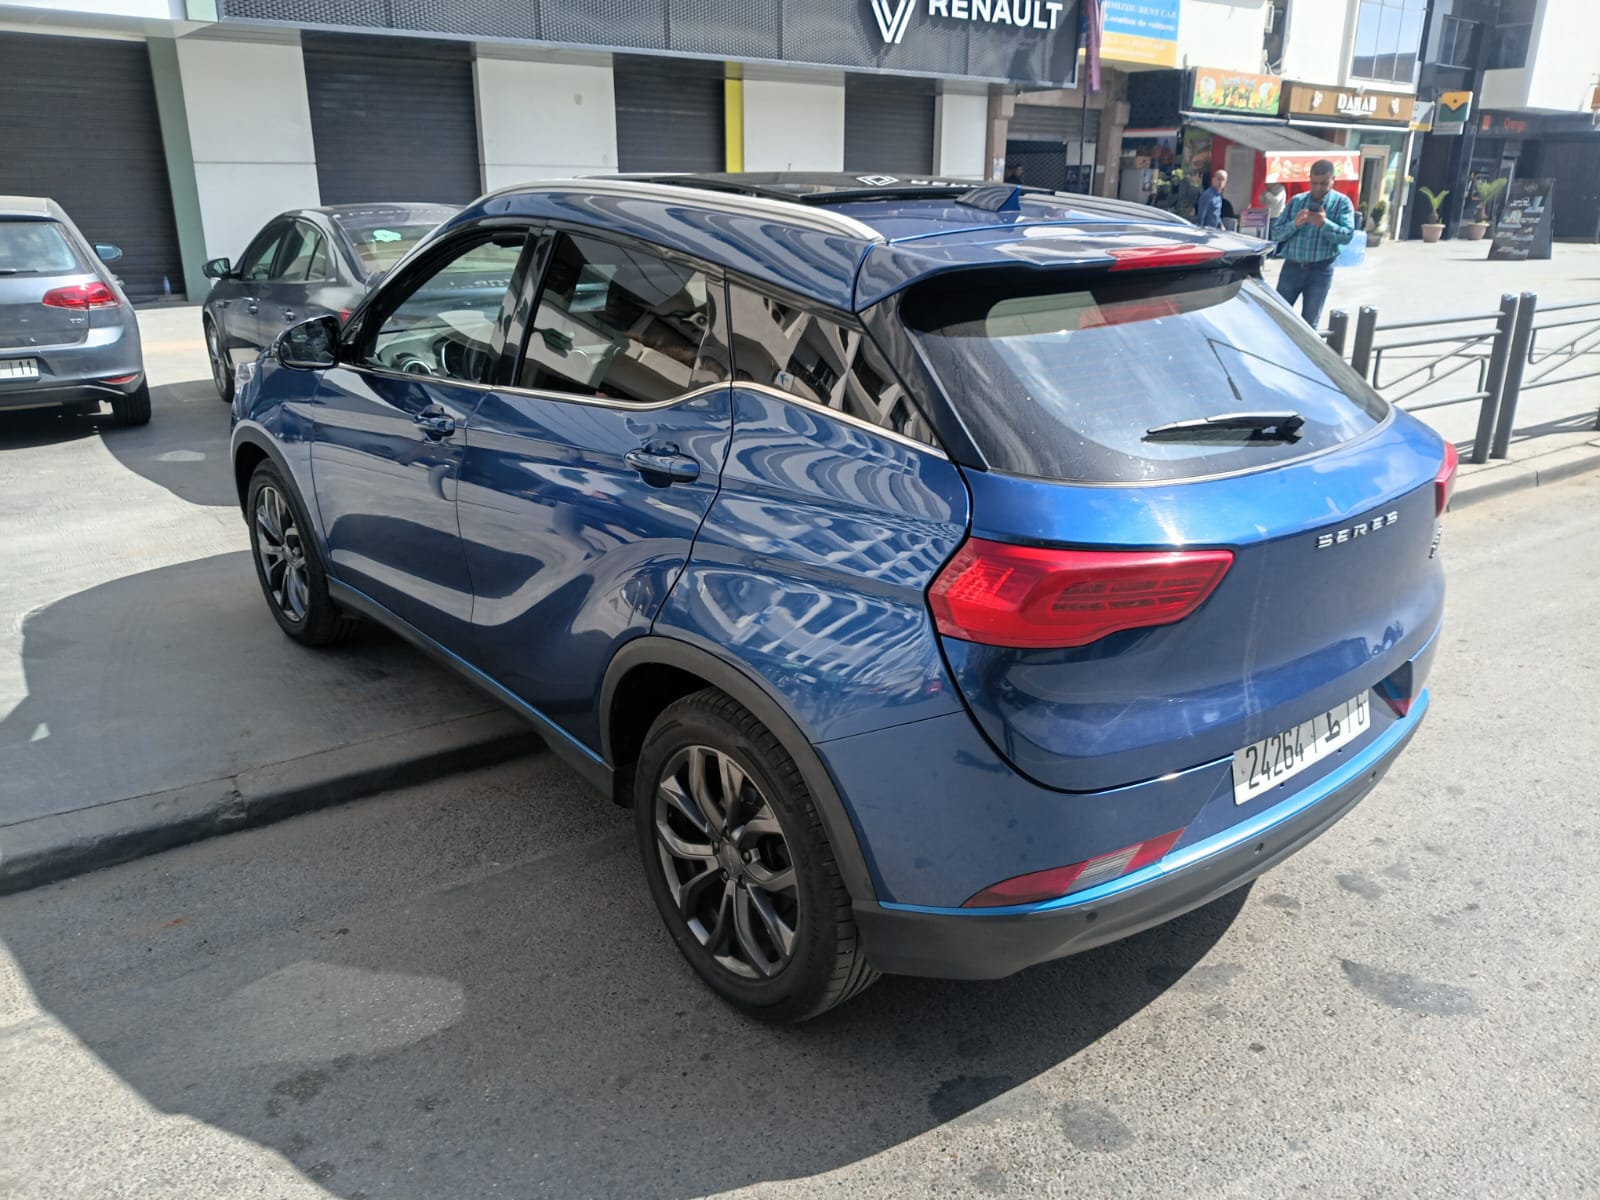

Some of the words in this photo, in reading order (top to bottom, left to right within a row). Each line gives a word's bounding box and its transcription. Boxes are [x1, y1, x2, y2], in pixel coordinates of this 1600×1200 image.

[928, 0, 1064, 30] RENAULT
[1337, 92, 1378, 112] DAHAB
[1316, 510, 1398, 549] SERES
[1246, 724, 1305, 790] 24264
